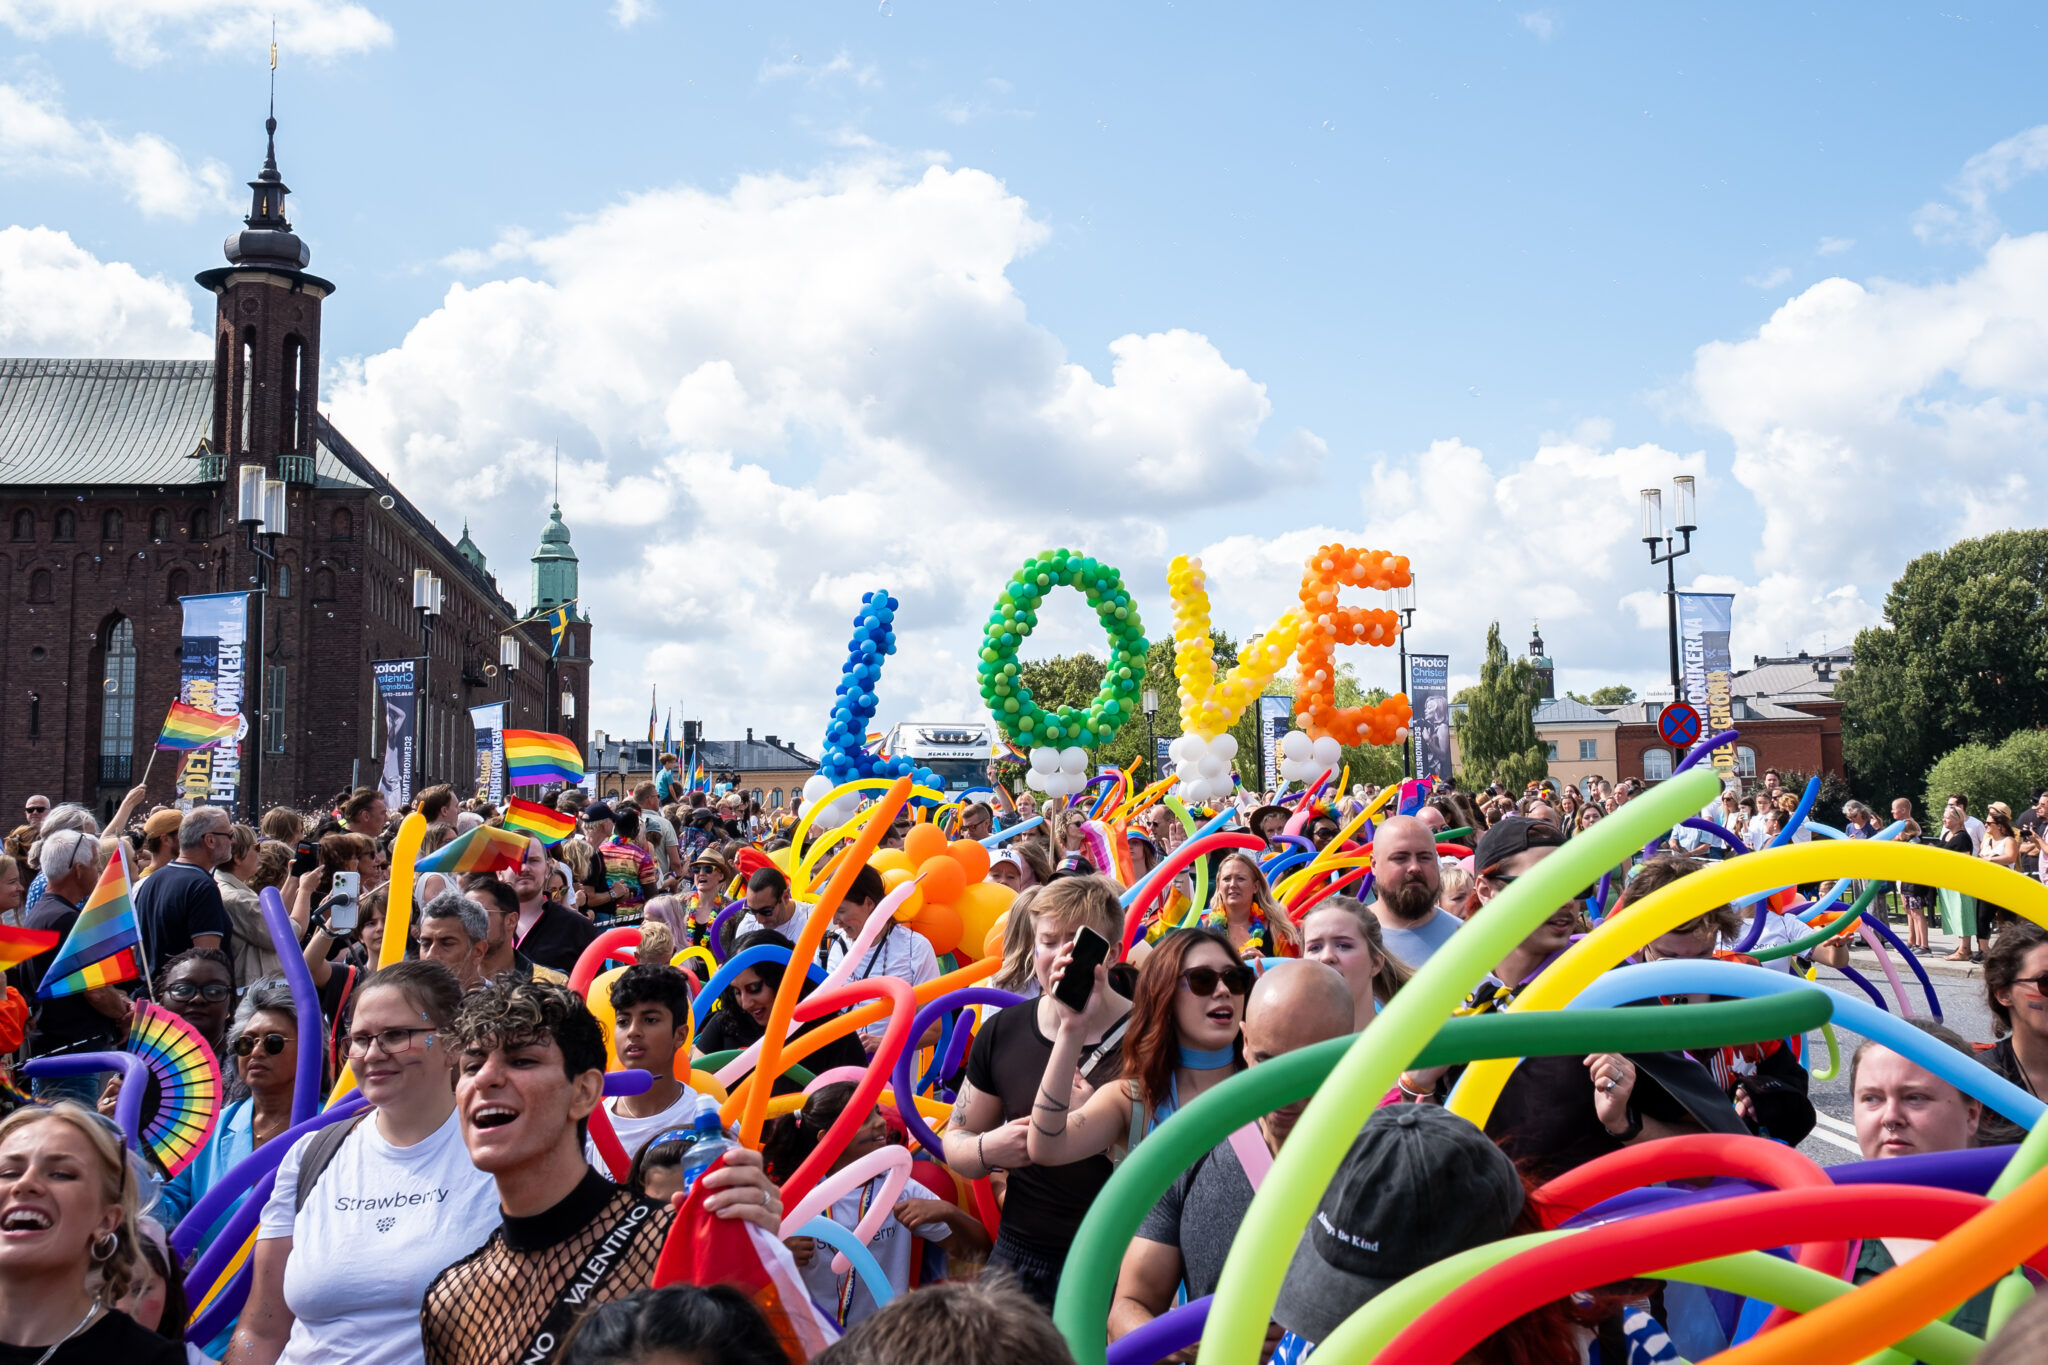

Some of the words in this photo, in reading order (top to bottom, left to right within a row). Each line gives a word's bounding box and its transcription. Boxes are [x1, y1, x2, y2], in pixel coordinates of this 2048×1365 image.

[1412, 656, 1447, 668] Photo:
[1412, 667, 1446, 677] Christer
[335, 1188, 449, 1212] Strawberry
[1351, 1235, 1379, 1252] Kind
[563, 1205, 649, 1304] VALENTINO
